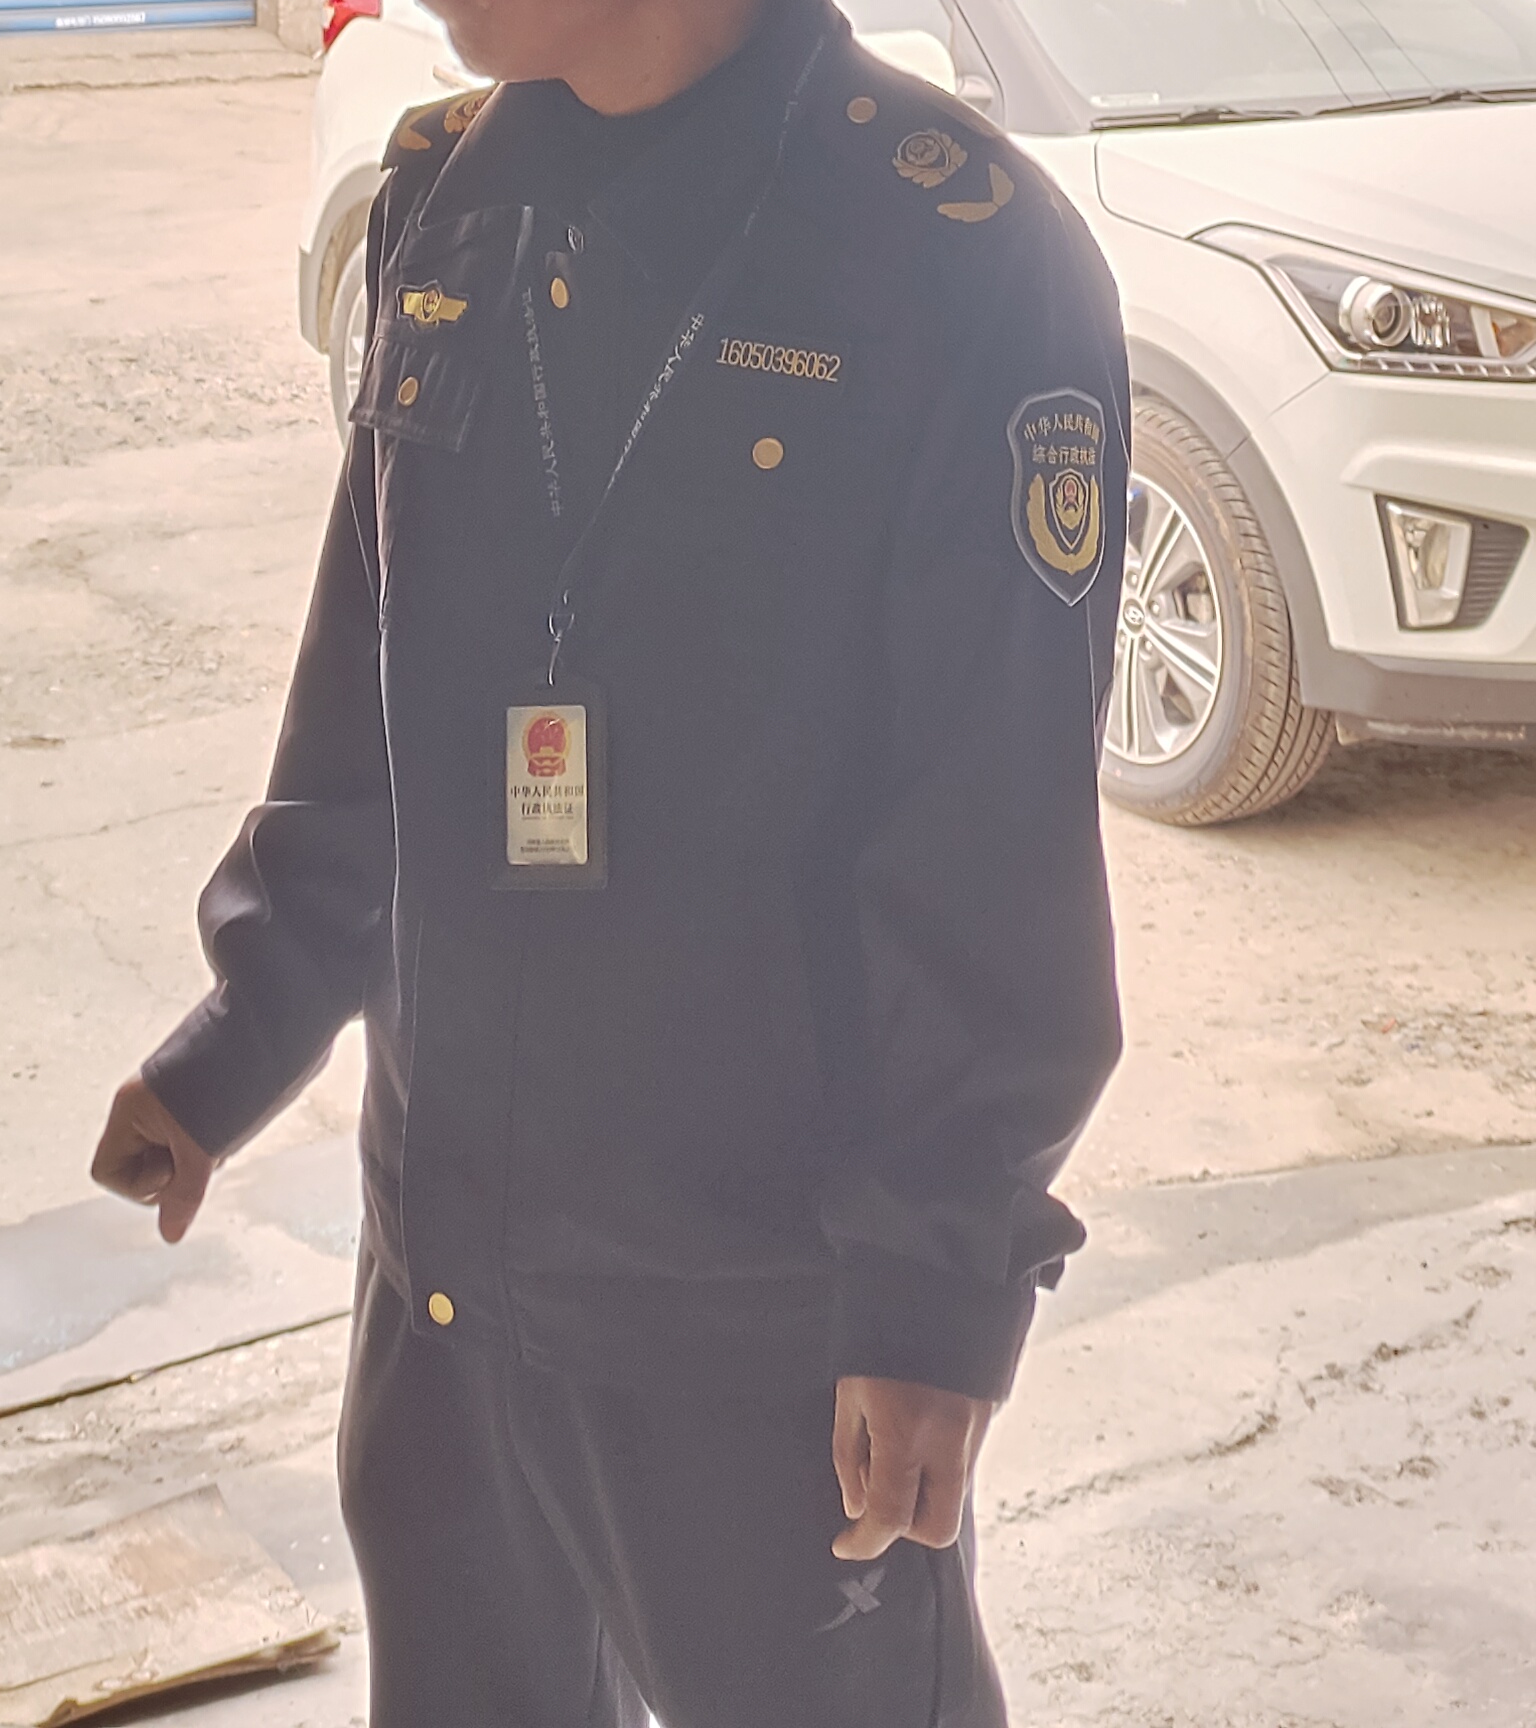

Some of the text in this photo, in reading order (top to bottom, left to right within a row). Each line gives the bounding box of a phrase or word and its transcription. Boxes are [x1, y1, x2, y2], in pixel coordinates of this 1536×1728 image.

[716, 337, 841, 382] 16050396062
[1024, 413, 1100, 445] 中华人民共和国
